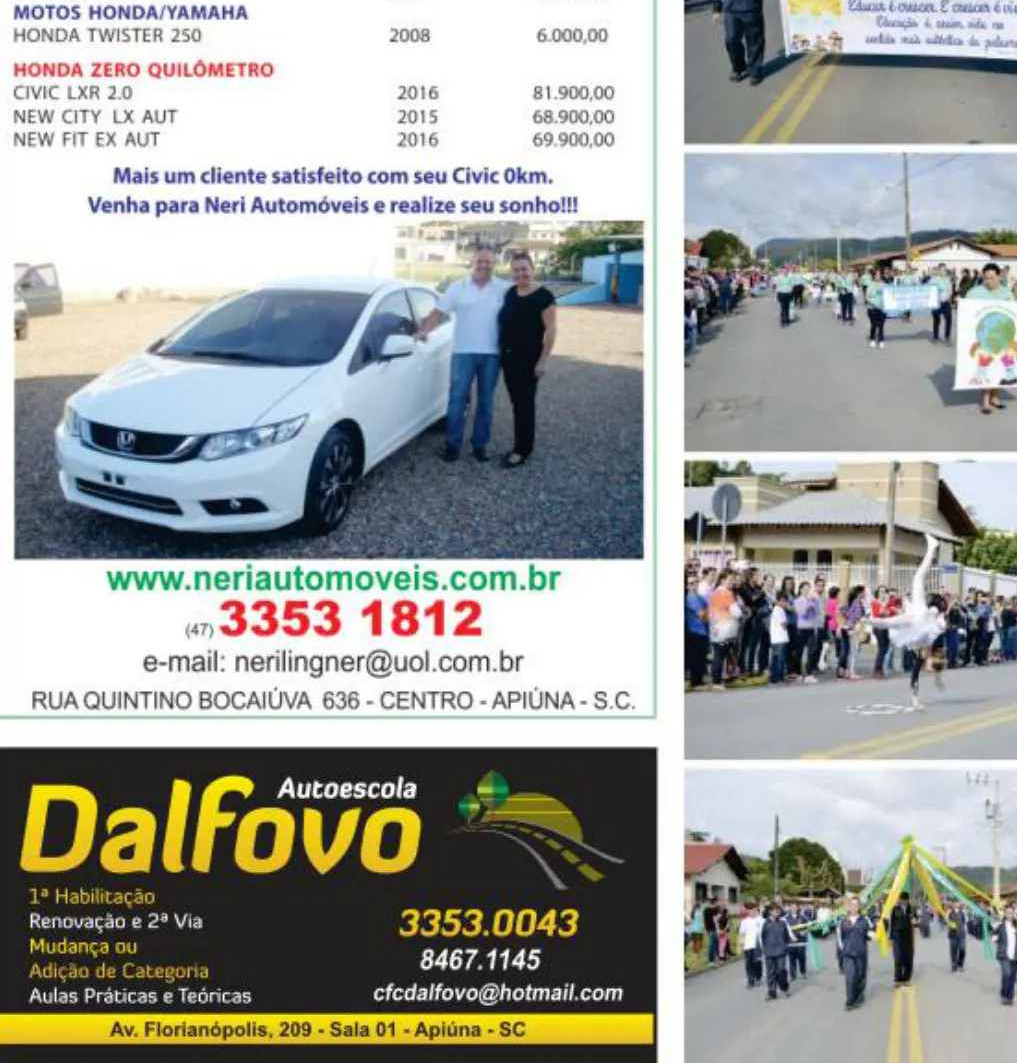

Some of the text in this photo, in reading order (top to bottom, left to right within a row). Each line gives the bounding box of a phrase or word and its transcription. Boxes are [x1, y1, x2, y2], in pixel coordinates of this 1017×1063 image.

[13, 4, 249, 21] MOTOS HONDA/YAMAHA
[889, 0, 895, 12] é
[994, 0, 1001, 13] é
[13, 59, 276, 80] HONDA ZERO QUILÔMETRO
[13, 84, 615, 102] CIVIC LXR 2.0 2016 81.900,00
[113, 166, 554, 185] Mais um cliente satisfeito com seu Civic 0km.
[87, 195, 579, 218] Venha para Neri Automóveis e realize seu sonho!!!
[106, 563, 562, 592] www.neriautomoveis.com.br
[185, 599, 483, 639] (47) 3353 1812
[142, 648, 525, 680] e-mail: nerilingner@uol.com.br
[31, 686, 636, 711] RUA QUINTINO BOCAIÚVA 636 CENTRO APIÚNA S.C.
[277, 775, 417, 799] Autoescola
[18, 774, 423, 877] Dalfovo
[55, 887, 155, 908] Habilitação
[29, 912, 126, 934] Renovação
[131, 916, 143, 929] e
[173, 912, 203, 930] Via
[399, 908, 580, 938] 3353.0043
[29, 936, 138, 958] Mudança ou
[419, 947, 542, 971] 8467.1145
[28, 961, 209, 984] Adição de Categoria
[28, 986, 252, 1005] Aulas Práticas e Teóricas
[373, 982, 624, 1007] cfcdalfovo@hotmail.com
[110, 1021, 525, 1040] Av. Florianópolis, 209 Sala 01 Apiúna SC
